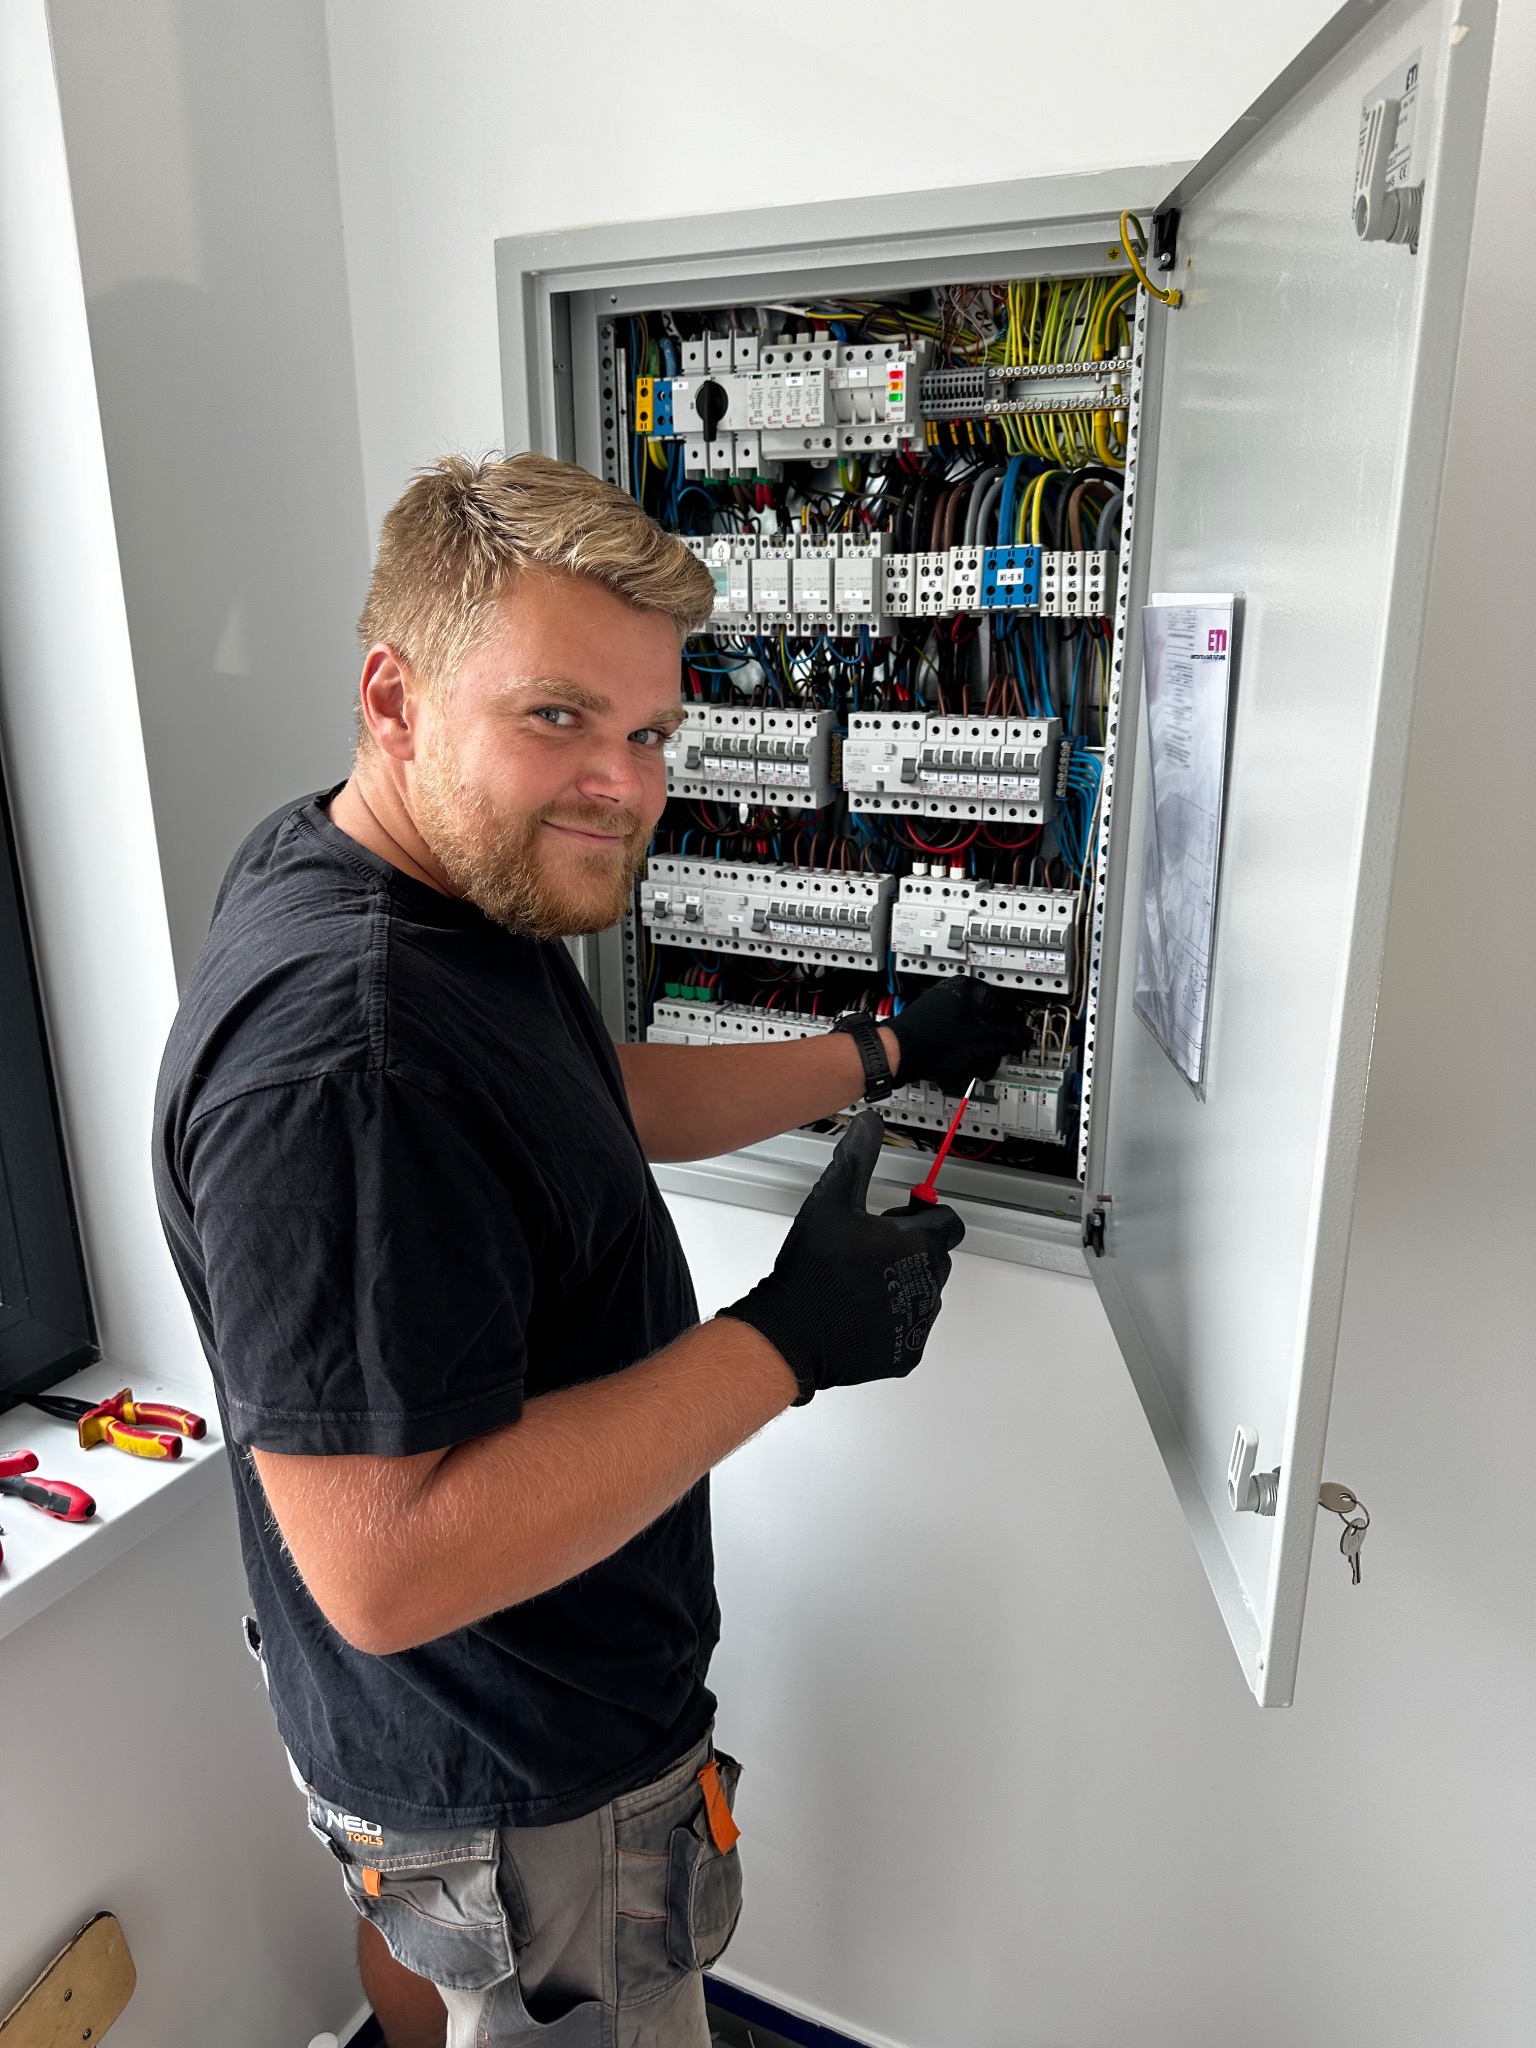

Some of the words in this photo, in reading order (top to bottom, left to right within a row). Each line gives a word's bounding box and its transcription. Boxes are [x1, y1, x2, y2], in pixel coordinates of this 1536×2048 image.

[929, 580, 936, 588] M2
[1208, 629, 1227, 652] ETI
[326, 1809, 382, 1836] NEO
[346, 1831, 384, 1846] TOOLS
